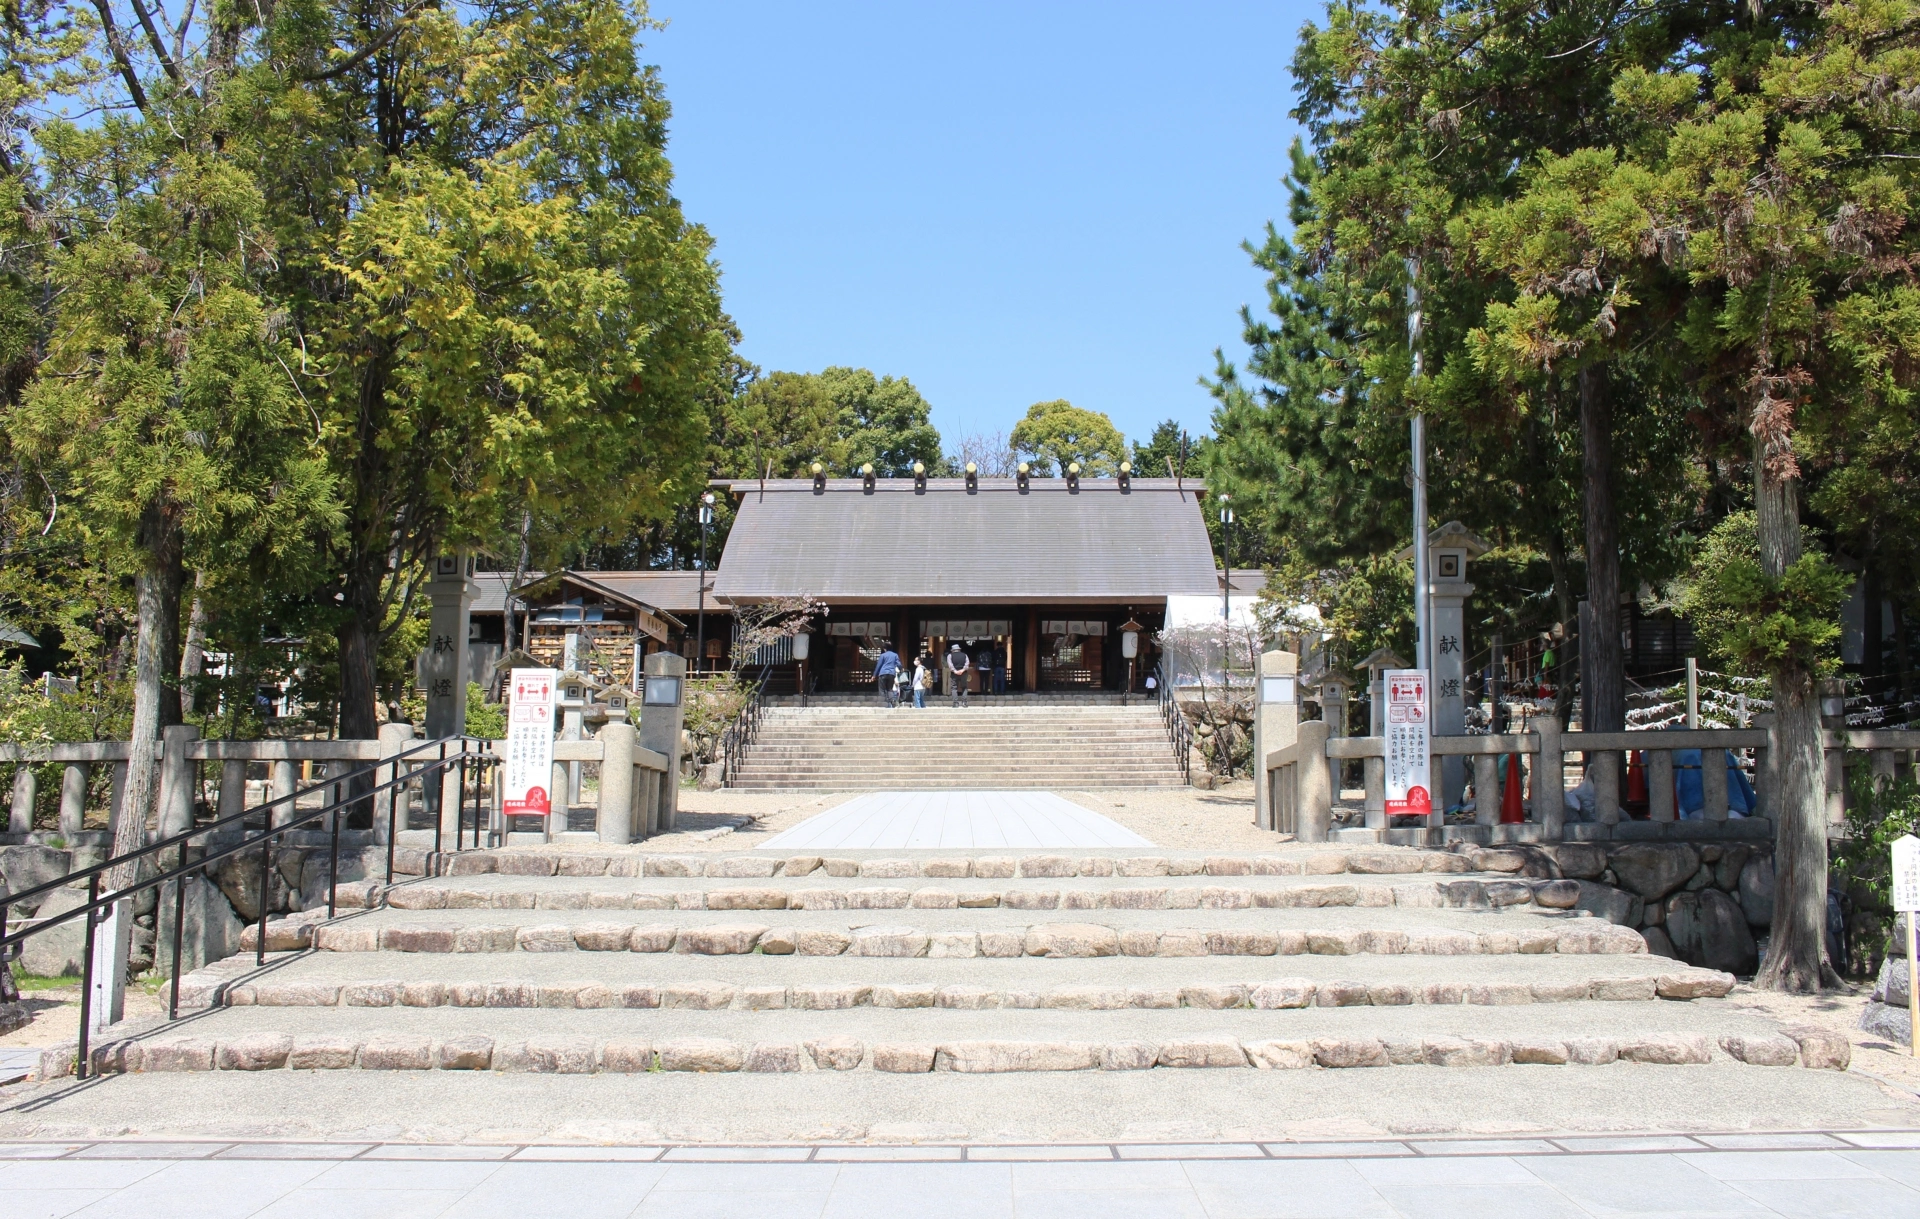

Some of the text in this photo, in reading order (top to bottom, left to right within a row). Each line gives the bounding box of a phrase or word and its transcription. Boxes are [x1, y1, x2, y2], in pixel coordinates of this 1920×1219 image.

[432, 635, 454, 698] 献燈
[1440, 635, 1460, 698] 献燈
[511, 727, 520, 788] ご協力お願いします
[520, 727, 529, 788] 順番にお参りください
[530, 727, 538, 767] 間隔を空けて
[539, 727, 547, 767] ご参拝の際は
